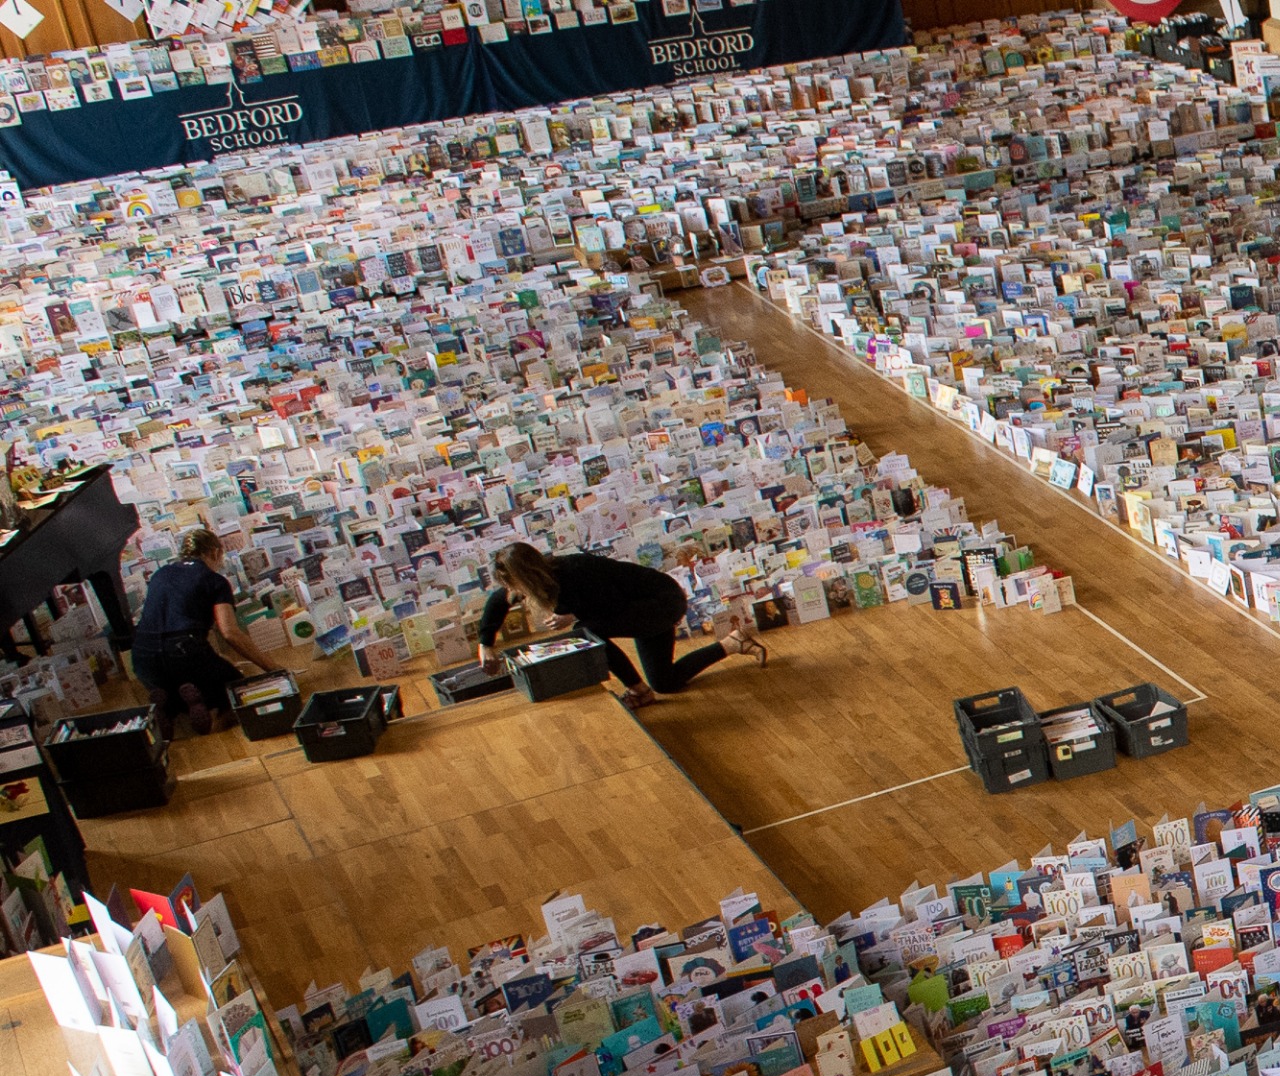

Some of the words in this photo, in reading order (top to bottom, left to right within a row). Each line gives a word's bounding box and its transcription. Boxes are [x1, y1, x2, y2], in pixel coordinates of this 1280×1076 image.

[650, 32, 755, 66] BEDFORD
[673, 57, 742, 77] SCHOOL
[184, 103, 304, 140] BEDFORD
[210, 130, 289, 153] SCHOOL
[230, 284, 255, 305] BIG
[102, 440, 118, 450] 100
[379, 648, 394, 661] 100
[1157, 828, 1186, 850] 100
[926, 902, 944, 916] 100
[1050, 896, 1080, 917] 100
[899, 935, 932, 949] THANK
[1115, 961, 1145, 981] 100
[433, 1014, 461, 1032] 100
